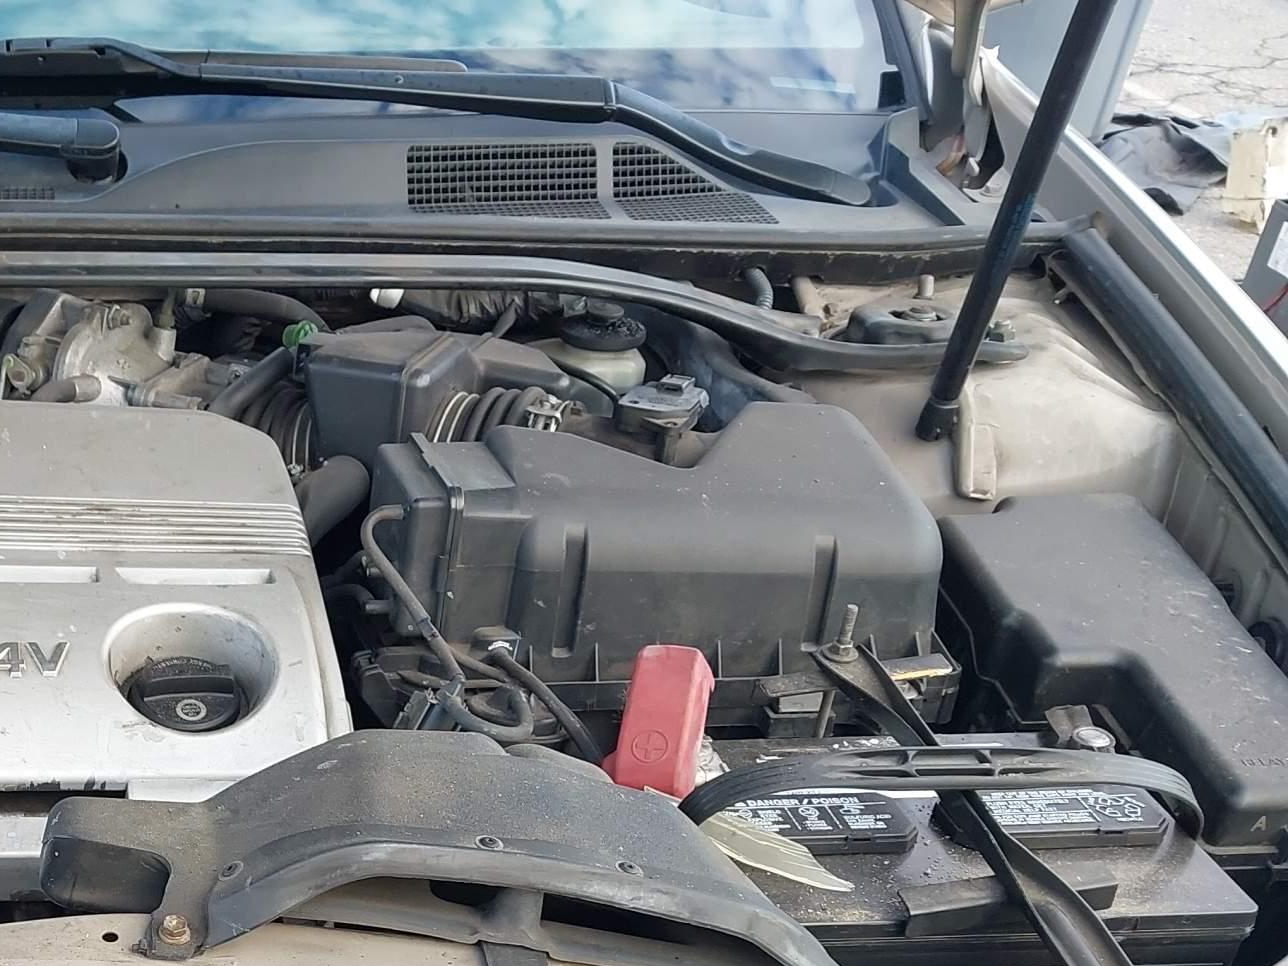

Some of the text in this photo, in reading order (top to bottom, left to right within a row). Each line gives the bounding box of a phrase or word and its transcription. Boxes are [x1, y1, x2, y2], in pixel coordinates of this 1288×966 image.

[746, 799, 800, 807] DANGER
[812, 796, 860, 805] POISON
[1250, 815, 1267, 832] A
